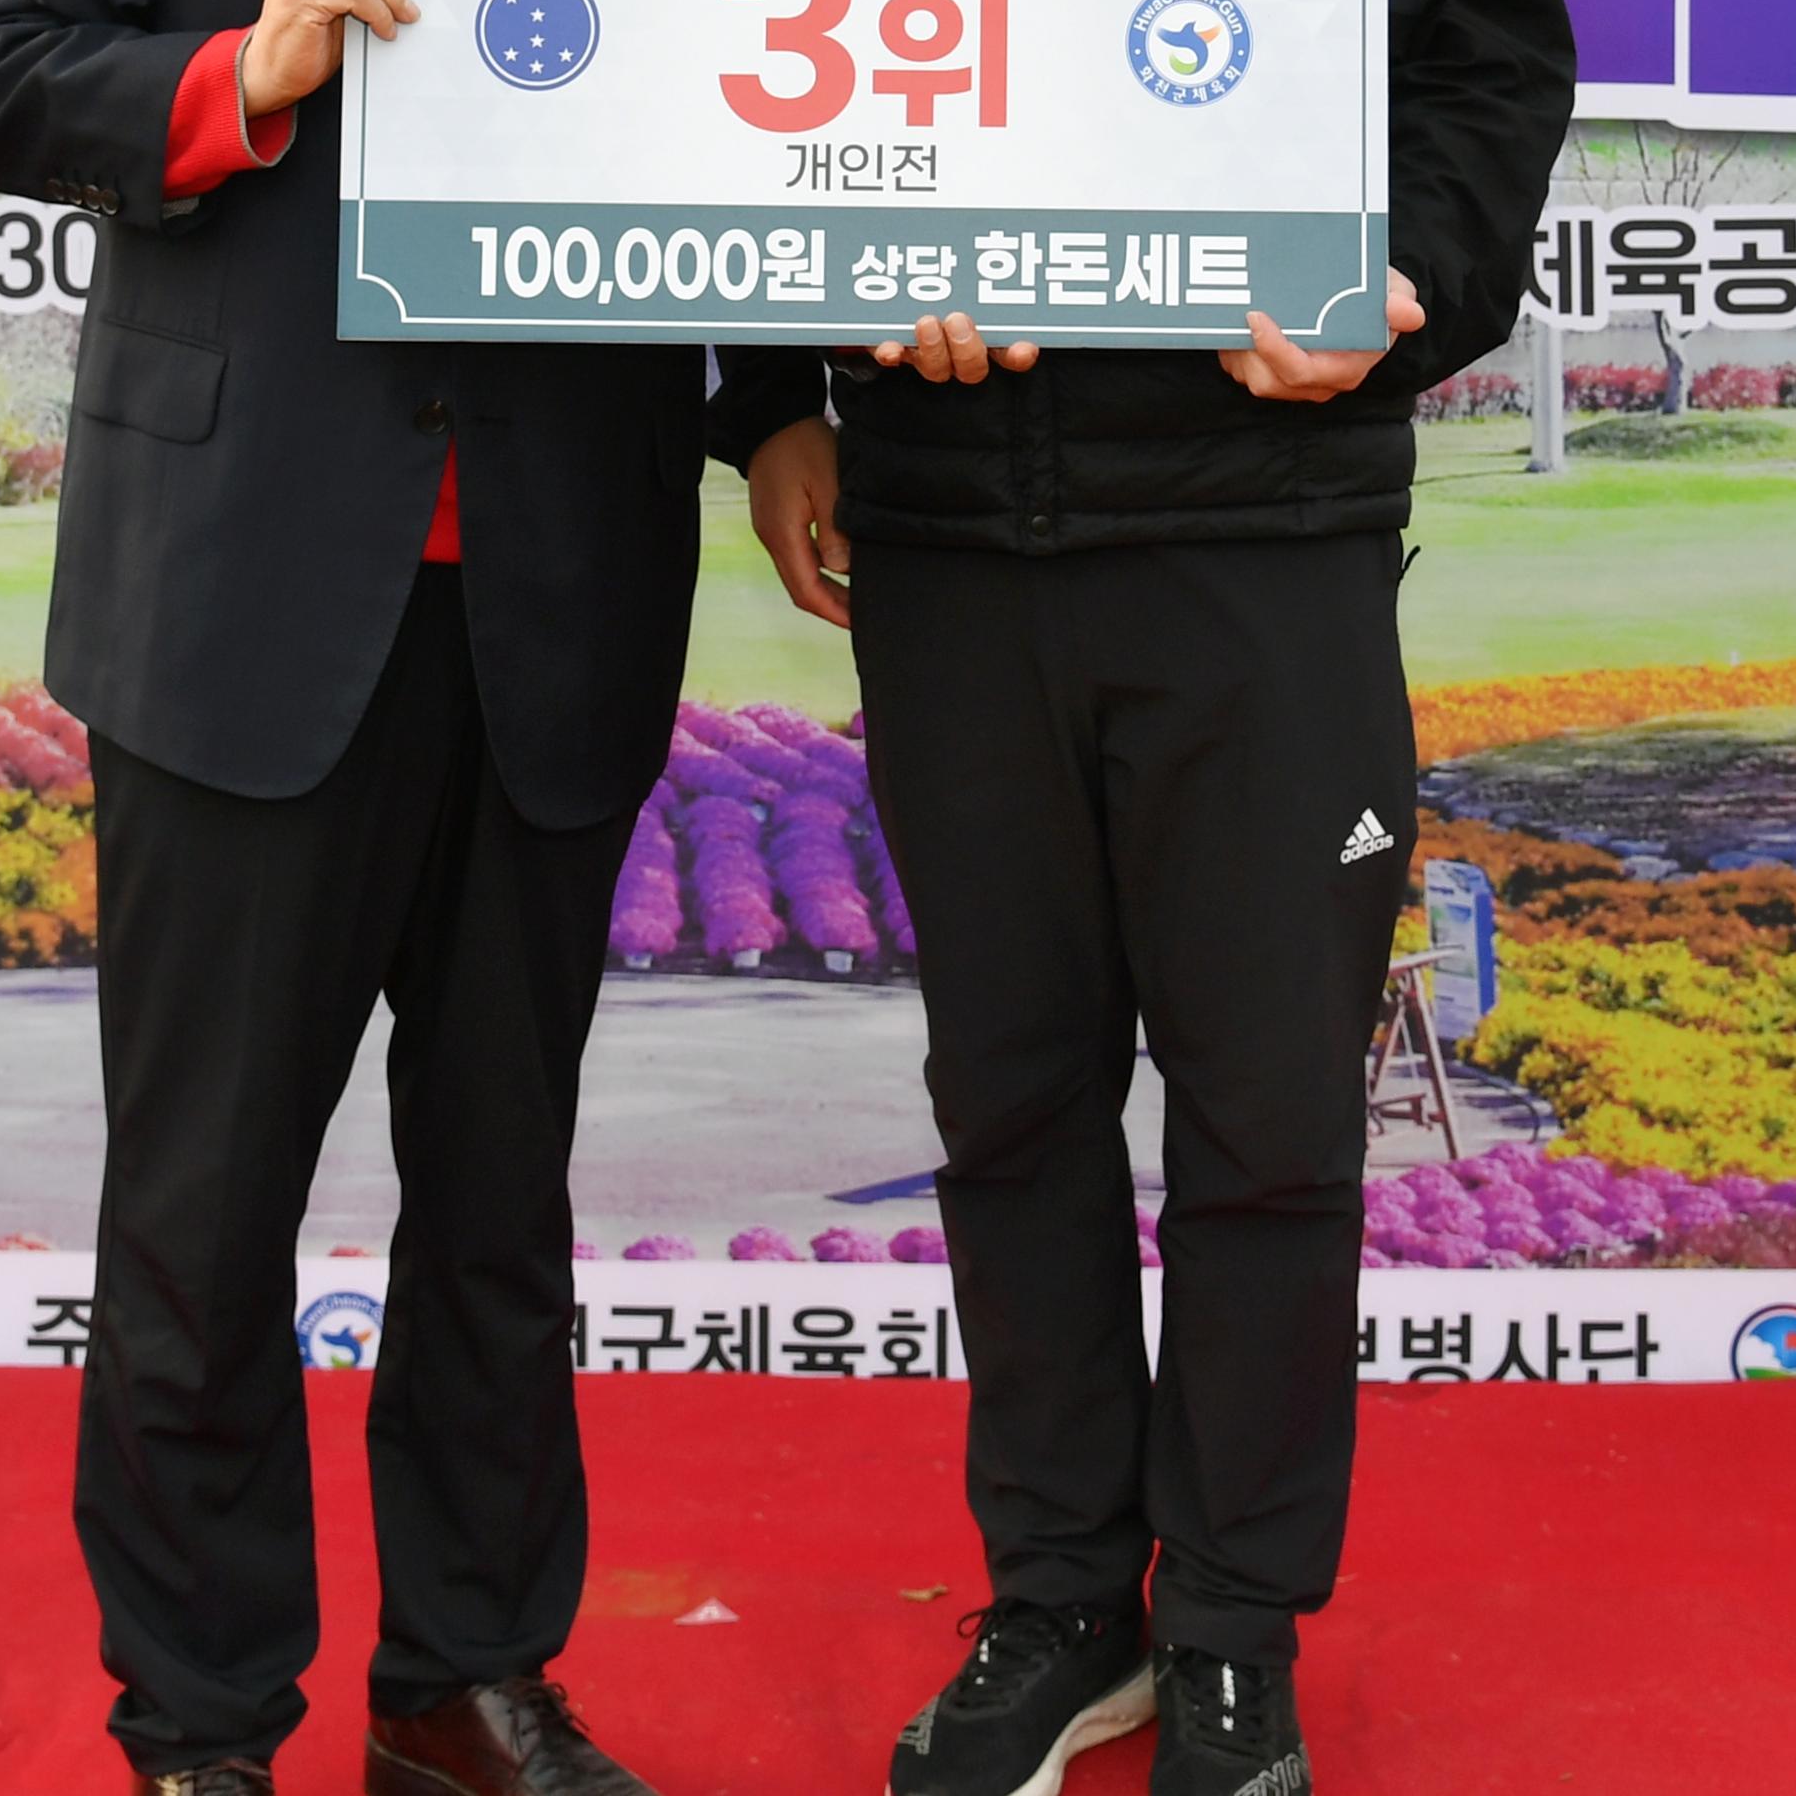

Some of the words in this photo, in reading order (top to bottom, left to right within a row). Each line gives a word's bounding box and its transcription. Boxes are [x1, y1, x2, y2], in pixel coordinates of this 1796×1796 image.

[785, 142, 939, 193] 개인전
[470, 224, 827, 305] 100,000원
[850, 243, 957, 303] 상당
[972, 229, 1253, 307] 한돈세트
[1339, 833, 1395, 865] adidas
